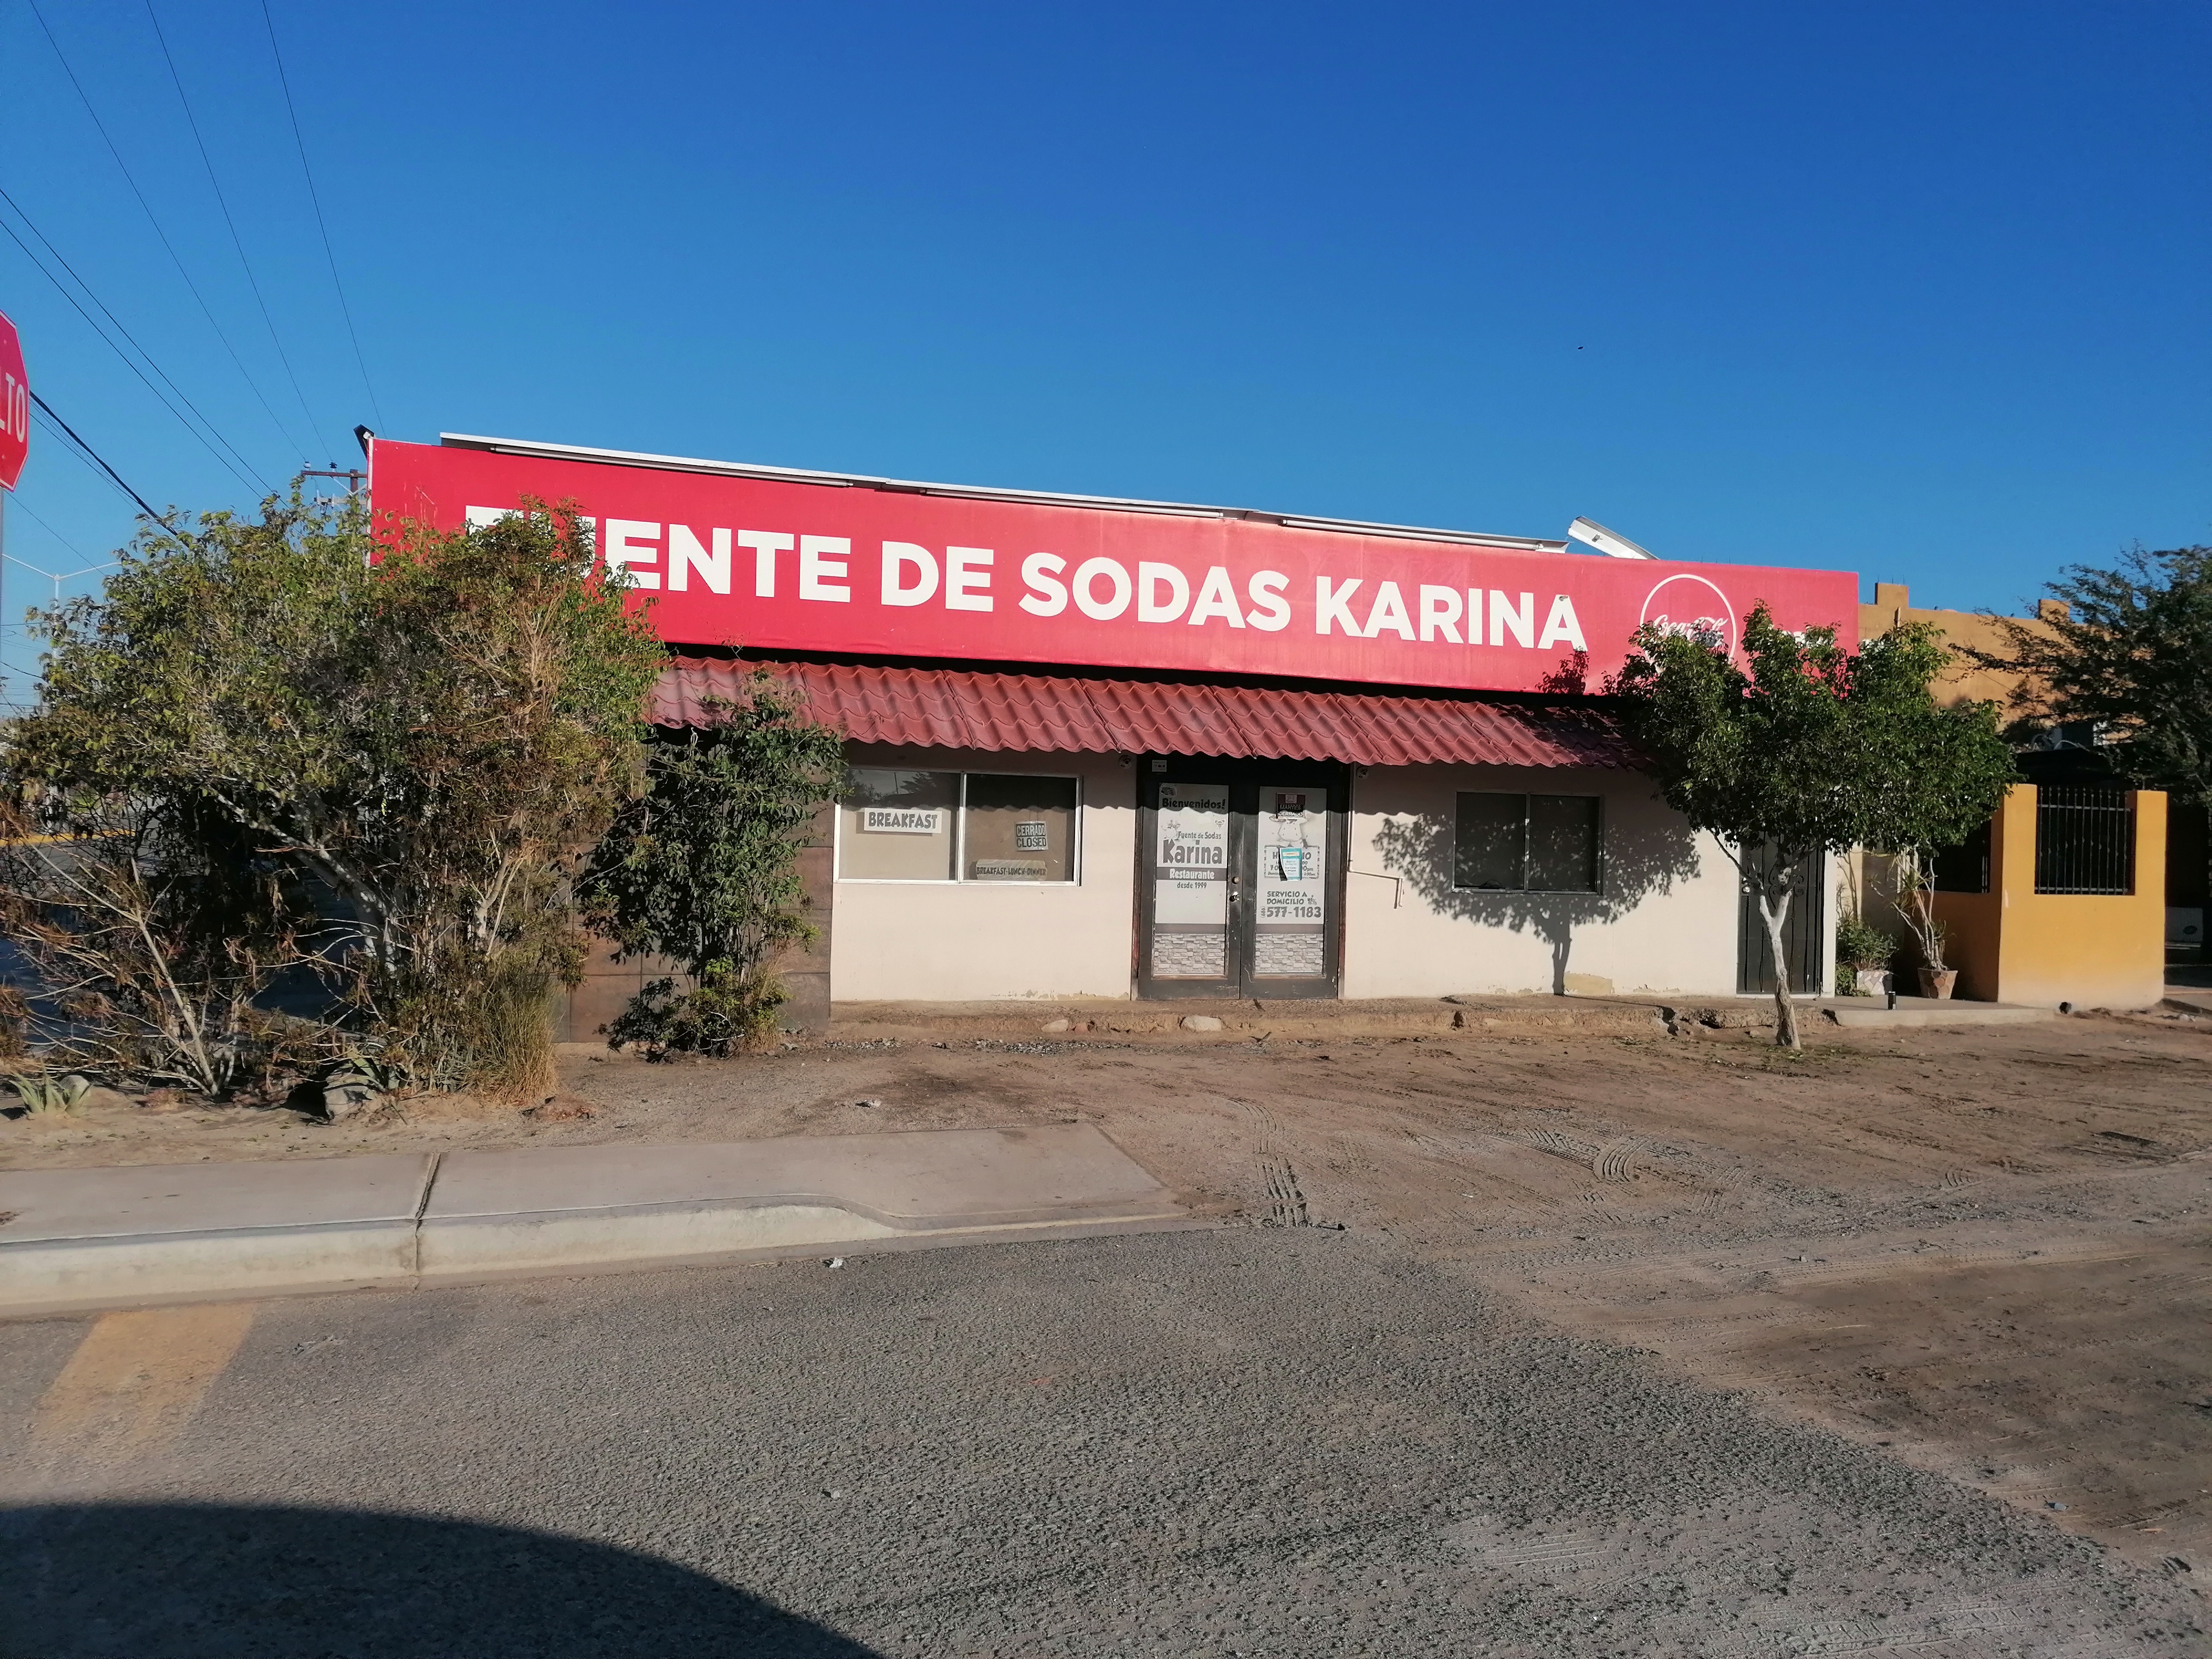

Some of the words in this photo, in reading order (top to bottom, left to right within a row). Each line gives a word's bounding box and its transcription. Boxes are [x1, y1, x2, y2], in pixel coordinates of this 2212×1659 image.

[0, 373, 25, 442] TO
[881, 540, 994, 612] DE
[1018, 552, 1291, 632] SODAS
[1316, 576, 1588, 651] KARINA
[1162, 798, 1226, 810] Bienvenidos!
[868, 811, 937, 829] BREAKFAST
[1016, 825, 1046, 836] CERRADO
[1017, 837, 1046, 847] CLOSED
[1163, 838, 1222, 864] Karina
[1169, 868, 1215, 879] Restaurante
[1266, 906, 1321, 918] 577-1183
